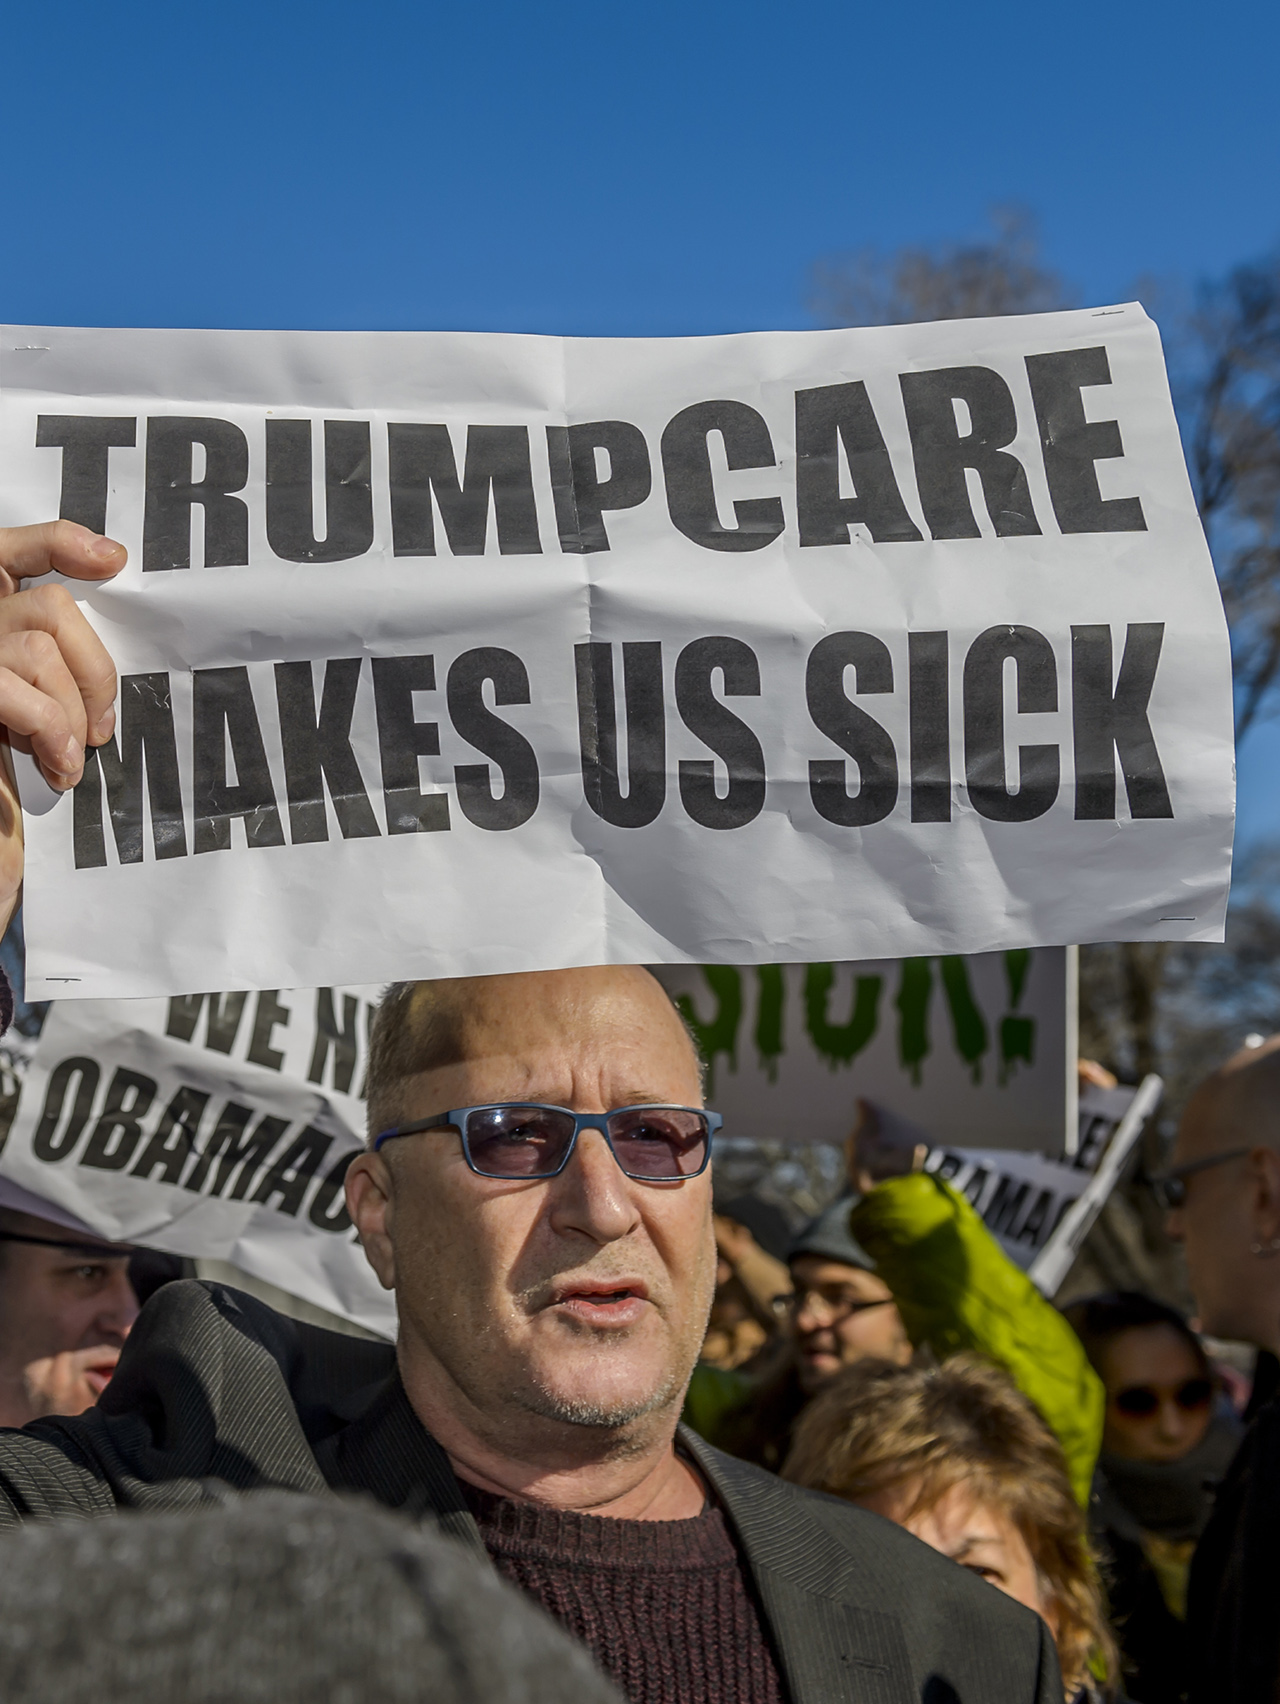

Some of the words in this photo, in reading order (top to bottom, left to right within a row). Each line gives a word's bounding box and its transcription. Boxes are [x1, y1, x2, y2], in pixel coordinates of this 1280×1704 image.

[35, 346, 1148, 572] TRUMPCARE
[72, 646, 539, 869] MAKES
[574, 635, 766, 830] US
[805, 622, 1174, 827] SICK
[33, 1056, 366, 1243] OBAMAC
